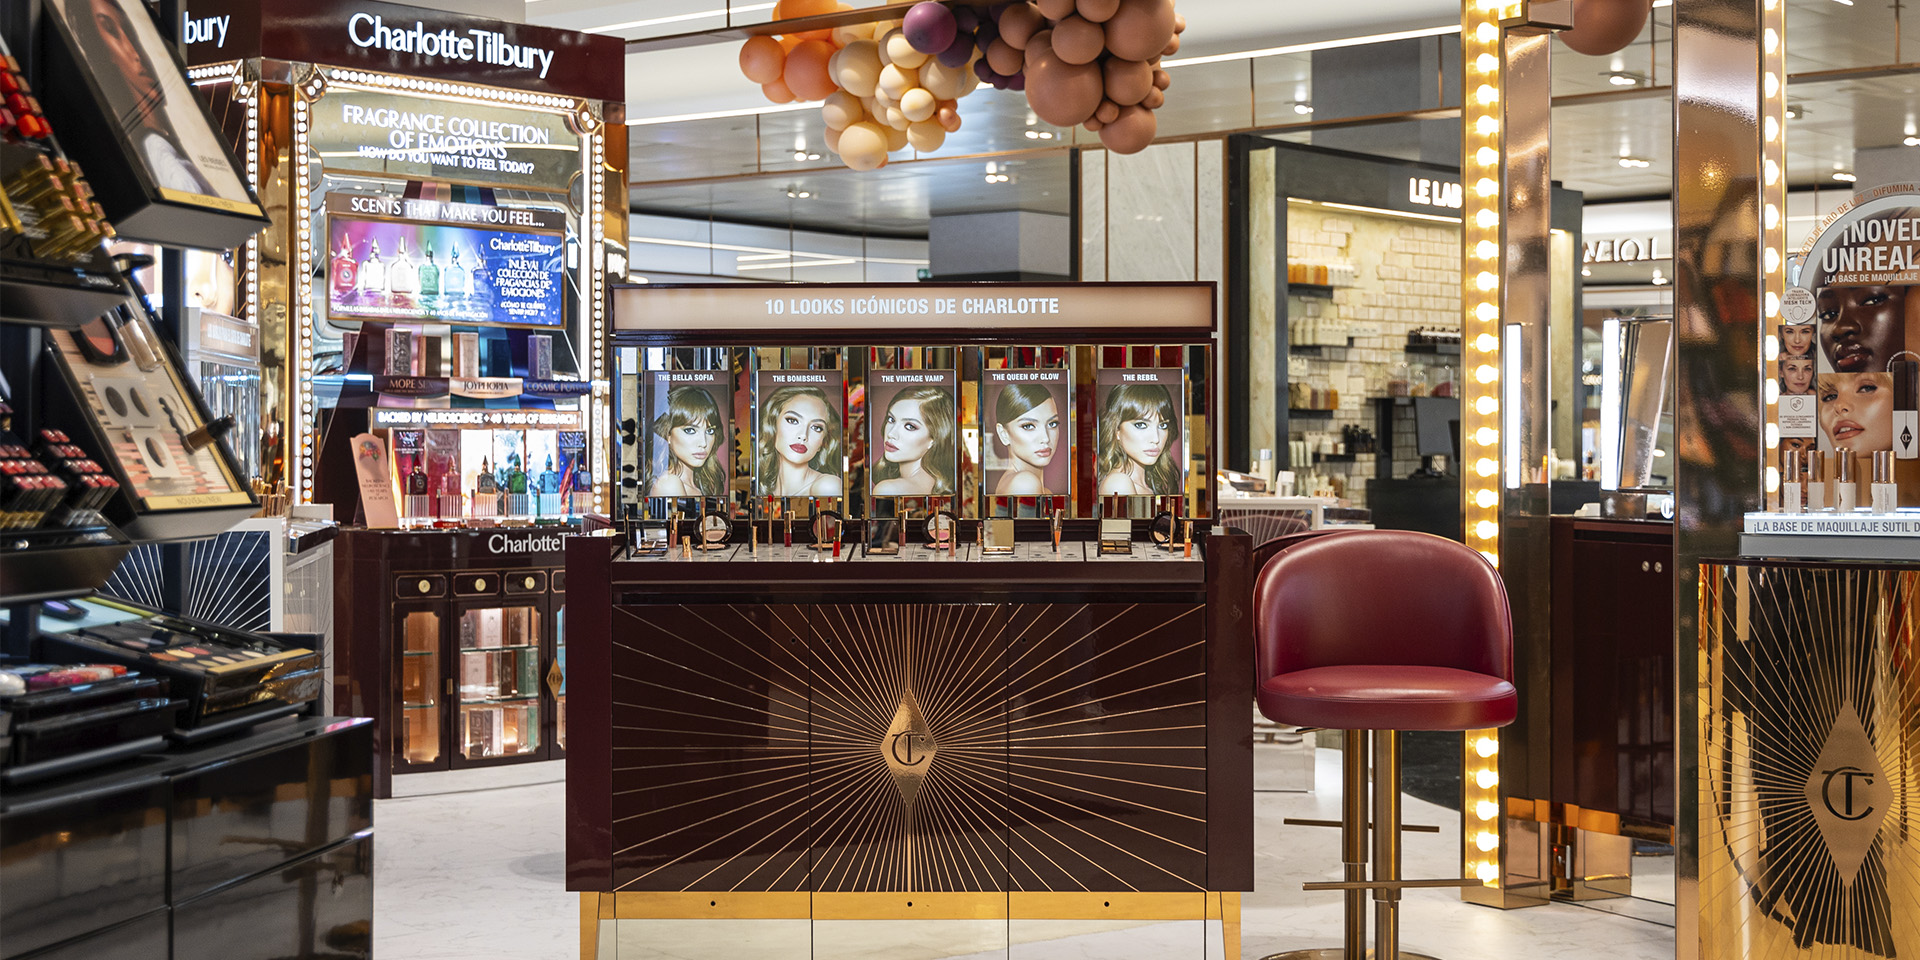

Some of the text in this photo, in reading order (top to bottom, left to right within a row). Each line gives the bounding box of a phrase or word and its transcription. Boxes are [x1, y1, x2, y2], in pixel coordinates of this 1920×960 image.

[184, 12, 230, 48] bury
[348, 12, 554, 79] CharlotteTilbury
[343, 105, 549, 145] FRAGRANCE COLLECTION
[389, 129, 508, 160] OF EMOTIONS
[358, 145, 536, 175] HOW DO YOU WANT TO FEEL TODAY?
[1409, 177, 1463, 209] LE LAB
[351, 197, 545, 228] SCENTS THAT MAKE YOU FEEL...
[1812, 225, 1823, 239] DE
[1822, 211, 1838, 227] ARO
[1837, 202, 1849, 215] DE
[1872, 183, 1915, 198] DIFUMINA
[489, 237, 555, 257] CharlotteTilbury
[1822, 245, 1920, 273] UNREAL
[539, 270, 550, 281] DE
[1838, 274, 1858, 283] BASE
[1860, 273, 1870, 282] DE
[1871, 272, 1918, 282] MAQUILLAJE
[495, 277, 551, 290] FRAGANCIAS DE
[501, 286, 546, 299] EMOCIONES
[765, 296, 1059, 315] 10 LOOKS ICÓNICOS DE CHARLOTTE
[658, 374, 714, 382] THE BELLA SOFIA
[881, 374, 944, 383] THE VINTAGE VAMP
[992, 373, 1059, 381] THE QUEEN OF GLOW
[1122, 374, 1158, 382] THE REBEL
[389, 379, 416, 390] MORE
[463, 381, 509, 392] JOYPHORIA
[526, 382, 559, 393] COSMIC
[377, 411, 411, 424] BACKED
[411, 411, 423, 424] BY
[423, 412, 484, 424] NEUROSCIENCE
[501, 413, 527, 425] YEARS
[527, 413, 539, 425] OF
[539, 413, 577, 425] RESEARCH
[1753, 522, 1769, 533] ¡LA
[1772, 522, 1798, 532] BASE
[1801, 522, 1813, 532] DE
[1817, 522, 1879, 532] MAQUILLAJE
[1882, 522, 1911, 532] SUTIL
[488, 531, 576, 554] CharlotteT
